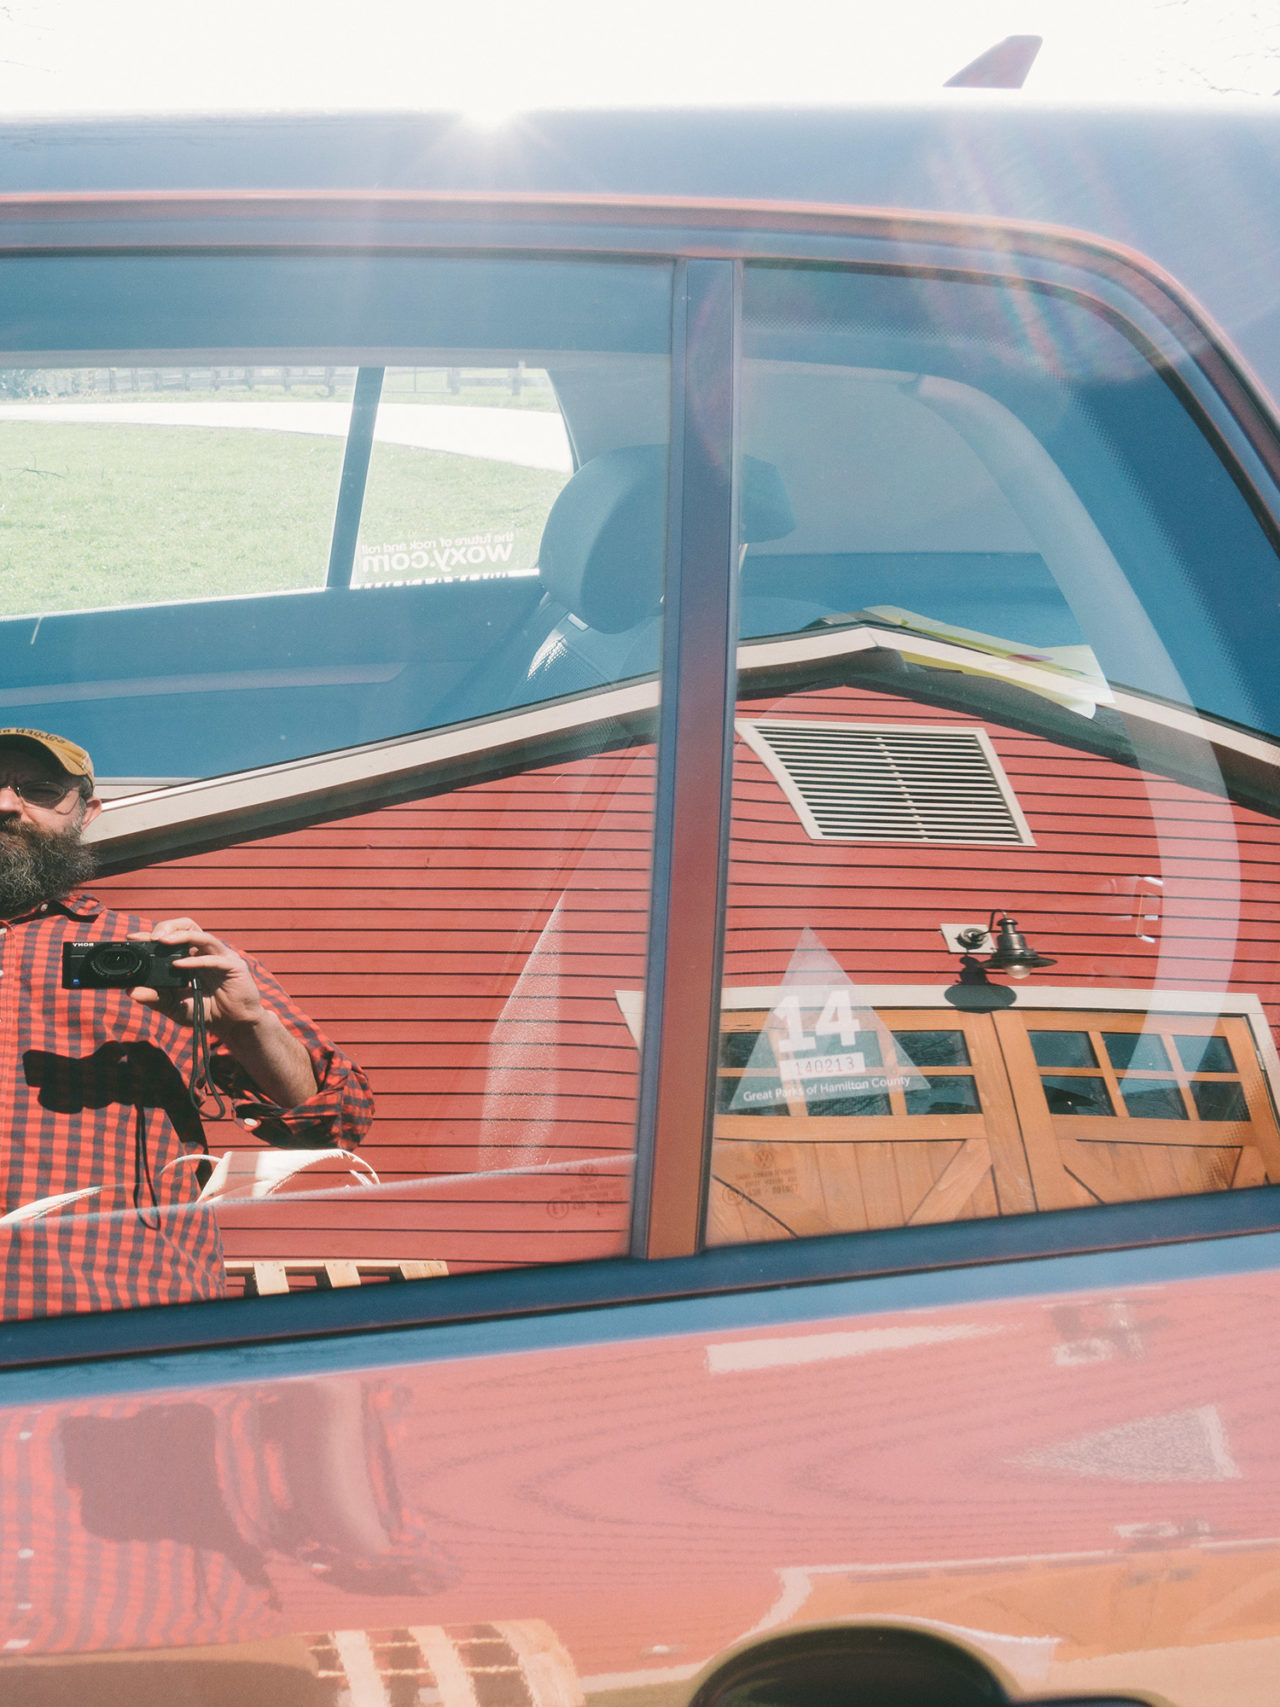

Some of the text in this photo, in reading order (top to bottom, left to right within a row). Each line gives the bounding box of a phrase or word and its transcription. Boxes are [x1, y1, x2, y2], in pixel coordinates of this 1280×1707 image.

[772, 990, 861, 1053] 14
[795, 1056, 855, 1076] 140213
[743, 1076, 911, 1101] Great Parks of Hamilton County
